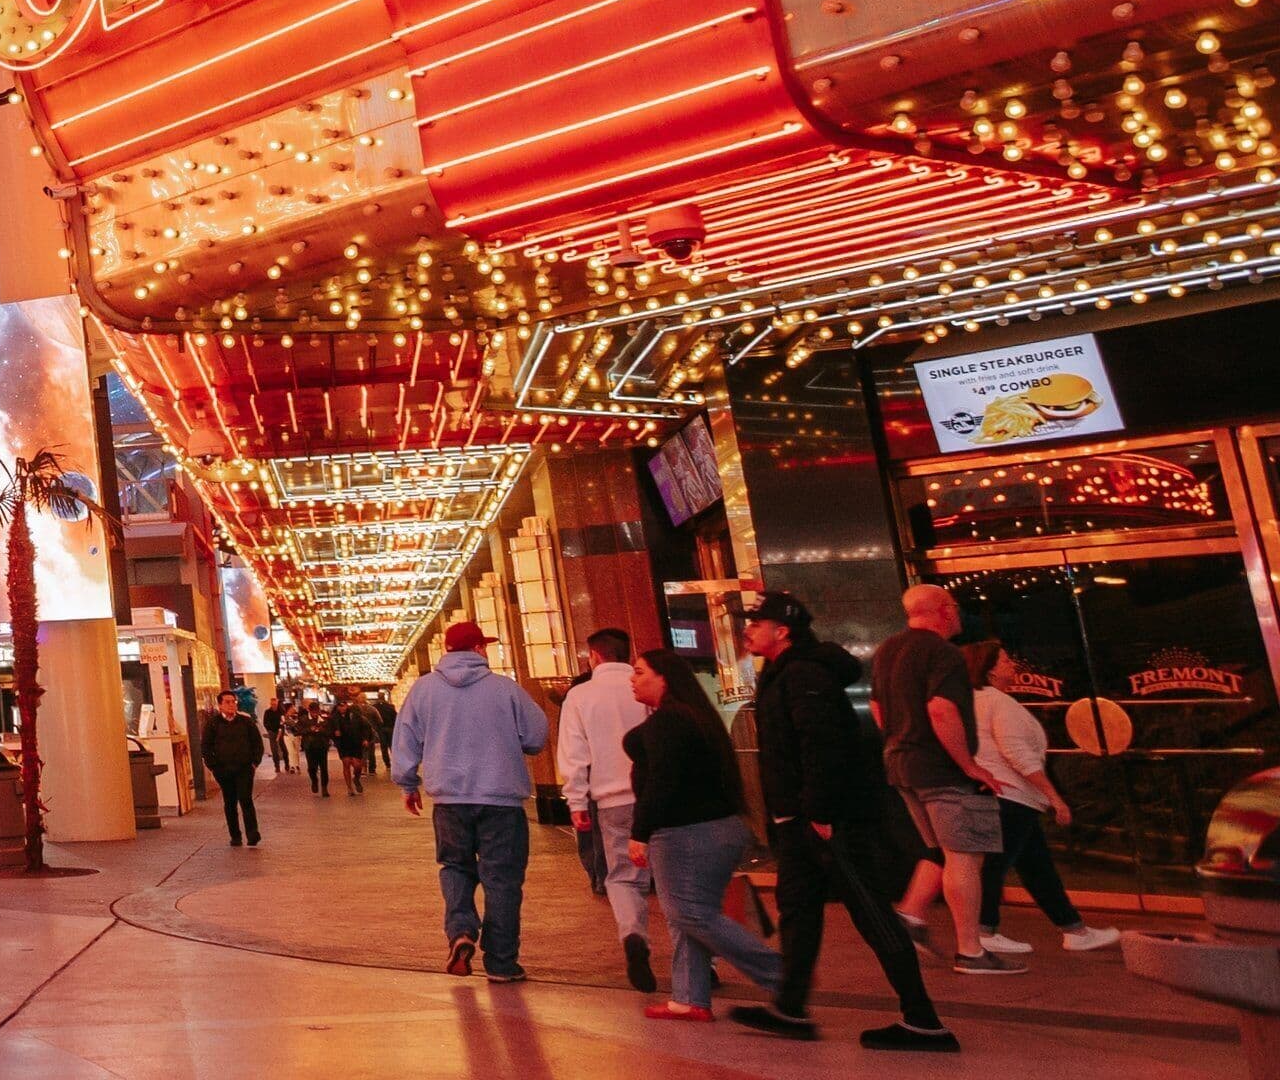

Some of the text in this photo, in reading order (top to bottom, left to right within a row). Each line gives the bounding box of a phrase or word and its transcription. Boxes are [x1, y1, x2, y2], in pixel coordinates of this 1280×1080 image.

[929, 345, 1084, 380] SINGLE STEAKBURGER
[958, 363, 1060, 385] with fries and soft drink
[999, 376, 1052, 393] COMBO
[141, 653, 168, 663] Photo
[1128, 666, 1243, 695] FREMONT
